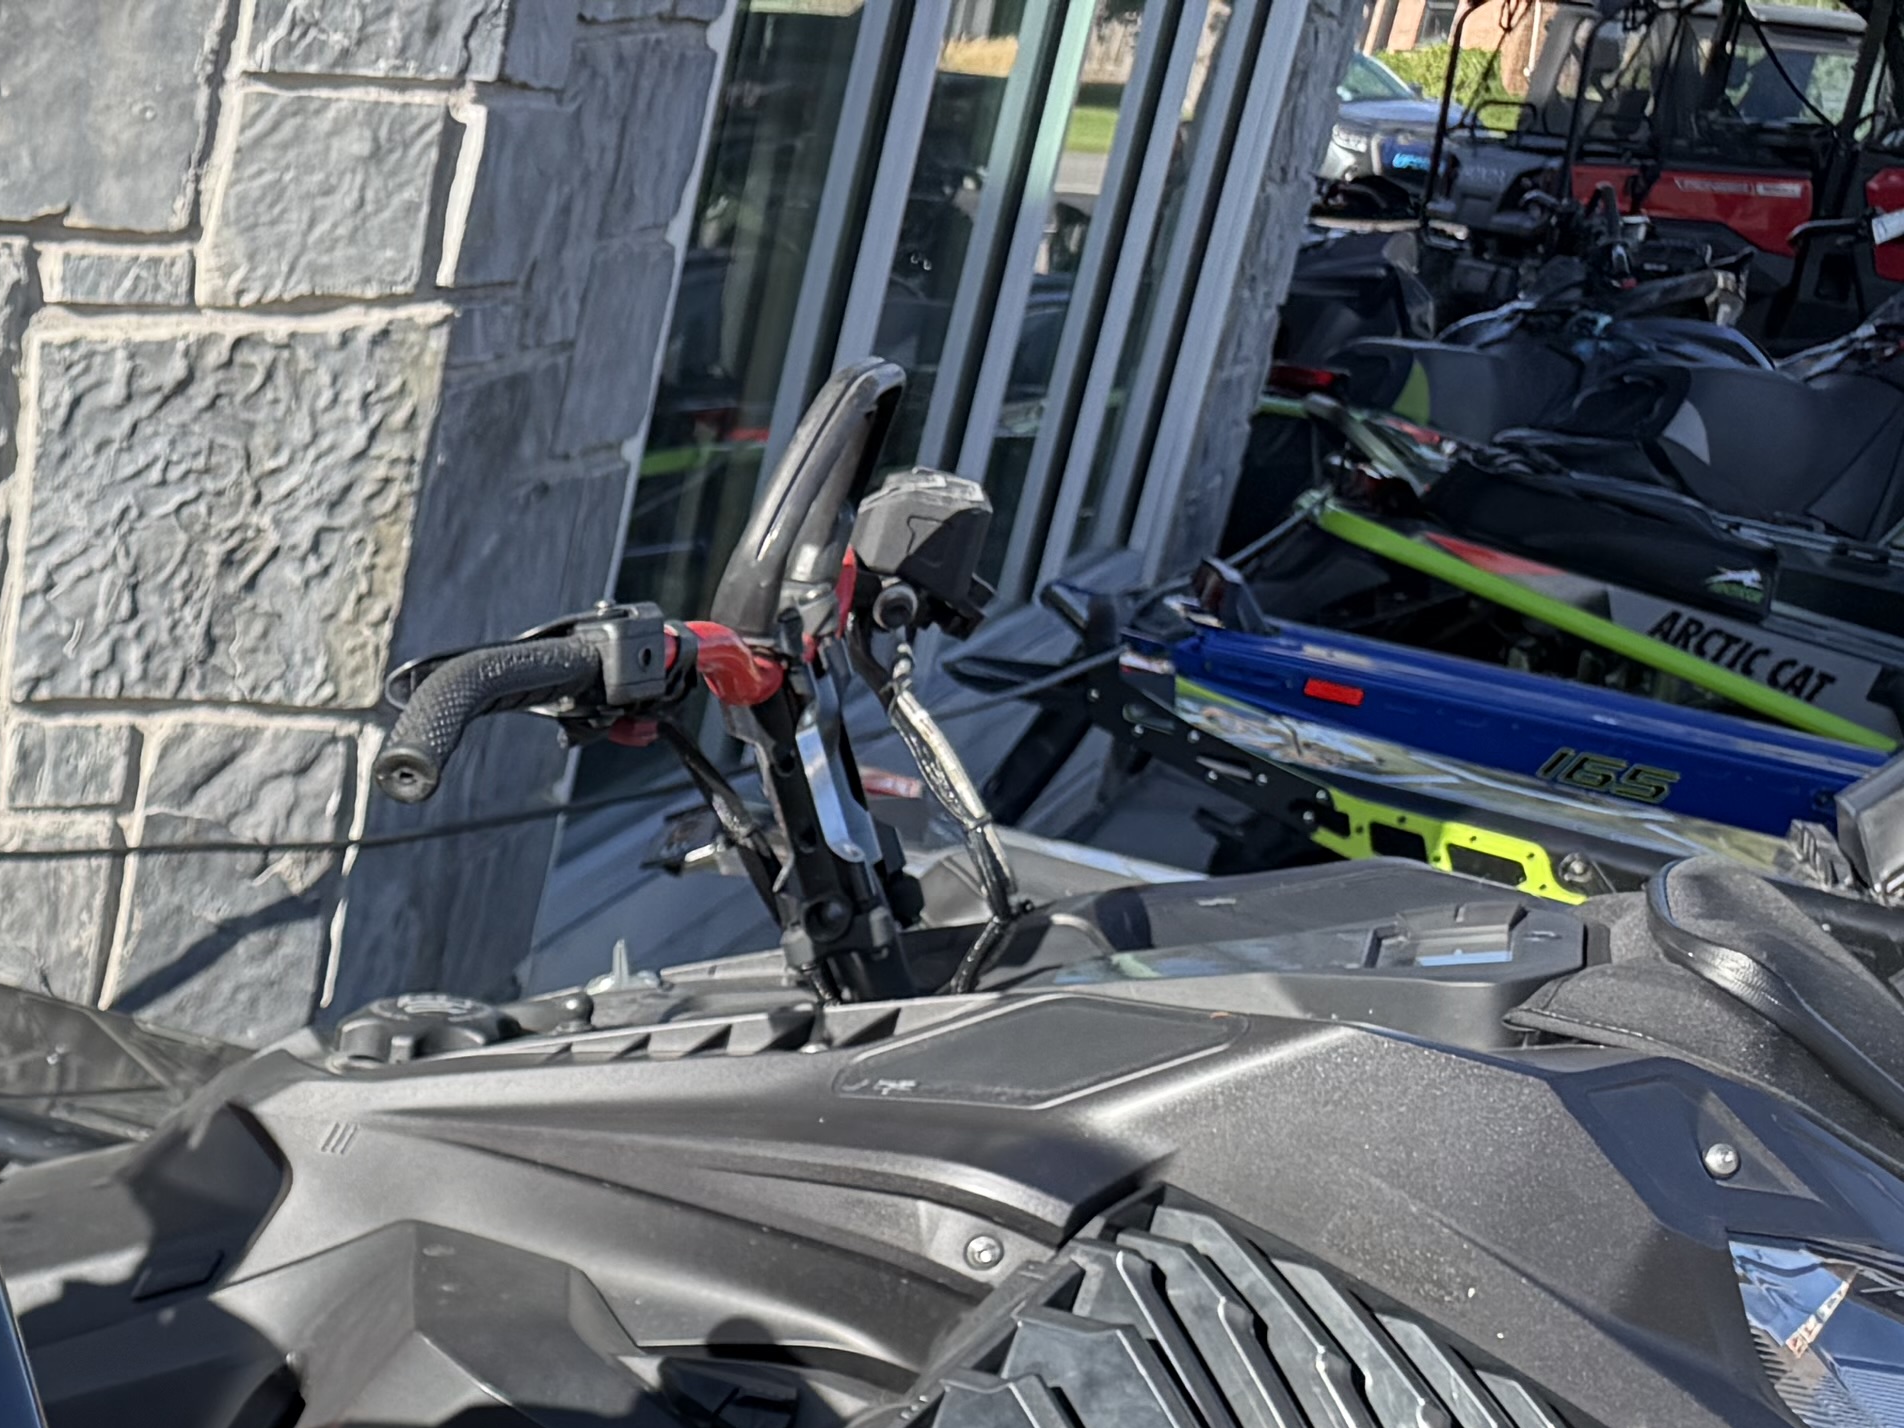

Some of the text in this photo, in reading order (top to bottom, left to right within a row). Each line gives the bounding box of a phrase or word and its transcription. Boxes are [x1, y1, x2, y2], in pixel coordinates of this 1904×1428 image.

[1645, 609, 1838, 703] ARCTIC CAT
[1536, 746, 1681, 803] 165
